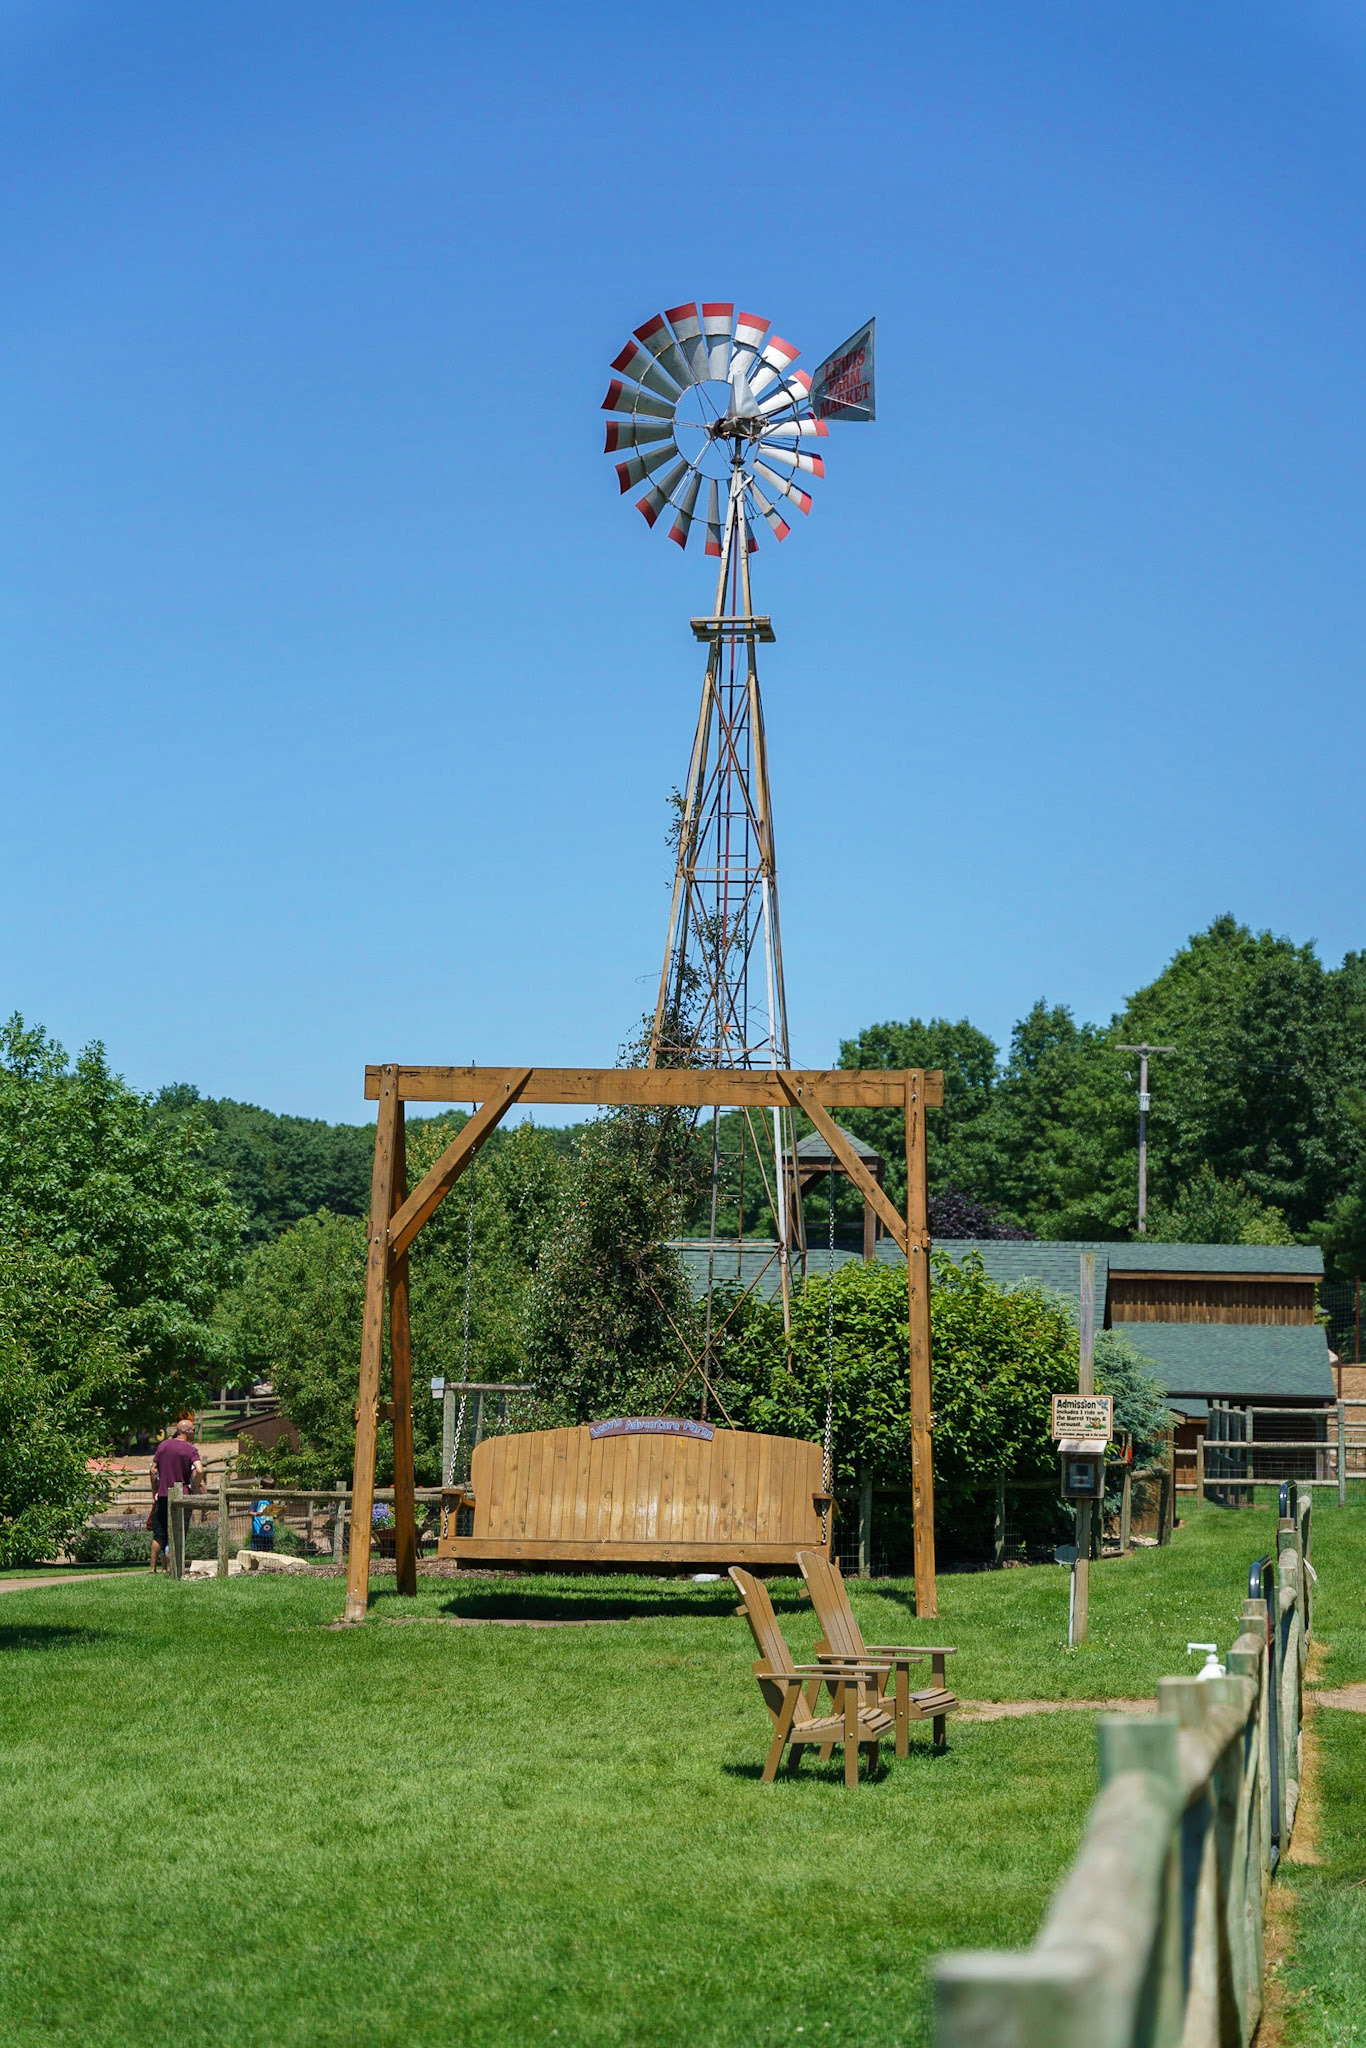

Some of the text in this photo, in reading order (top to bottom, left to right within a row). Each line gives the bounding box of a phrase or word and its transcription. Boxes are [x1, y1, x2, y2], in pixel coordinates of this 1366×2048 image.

[824, 347, 866, 381] LEWIS
[828, 368, 861, 397] FARM
[820, 381, 870, 419] MARKET
[1056, 1399, 1096, 1409] Admission
[590, 1418, 623, 1438] Lewis
[624, 1419, 680, 1431] Adventure
